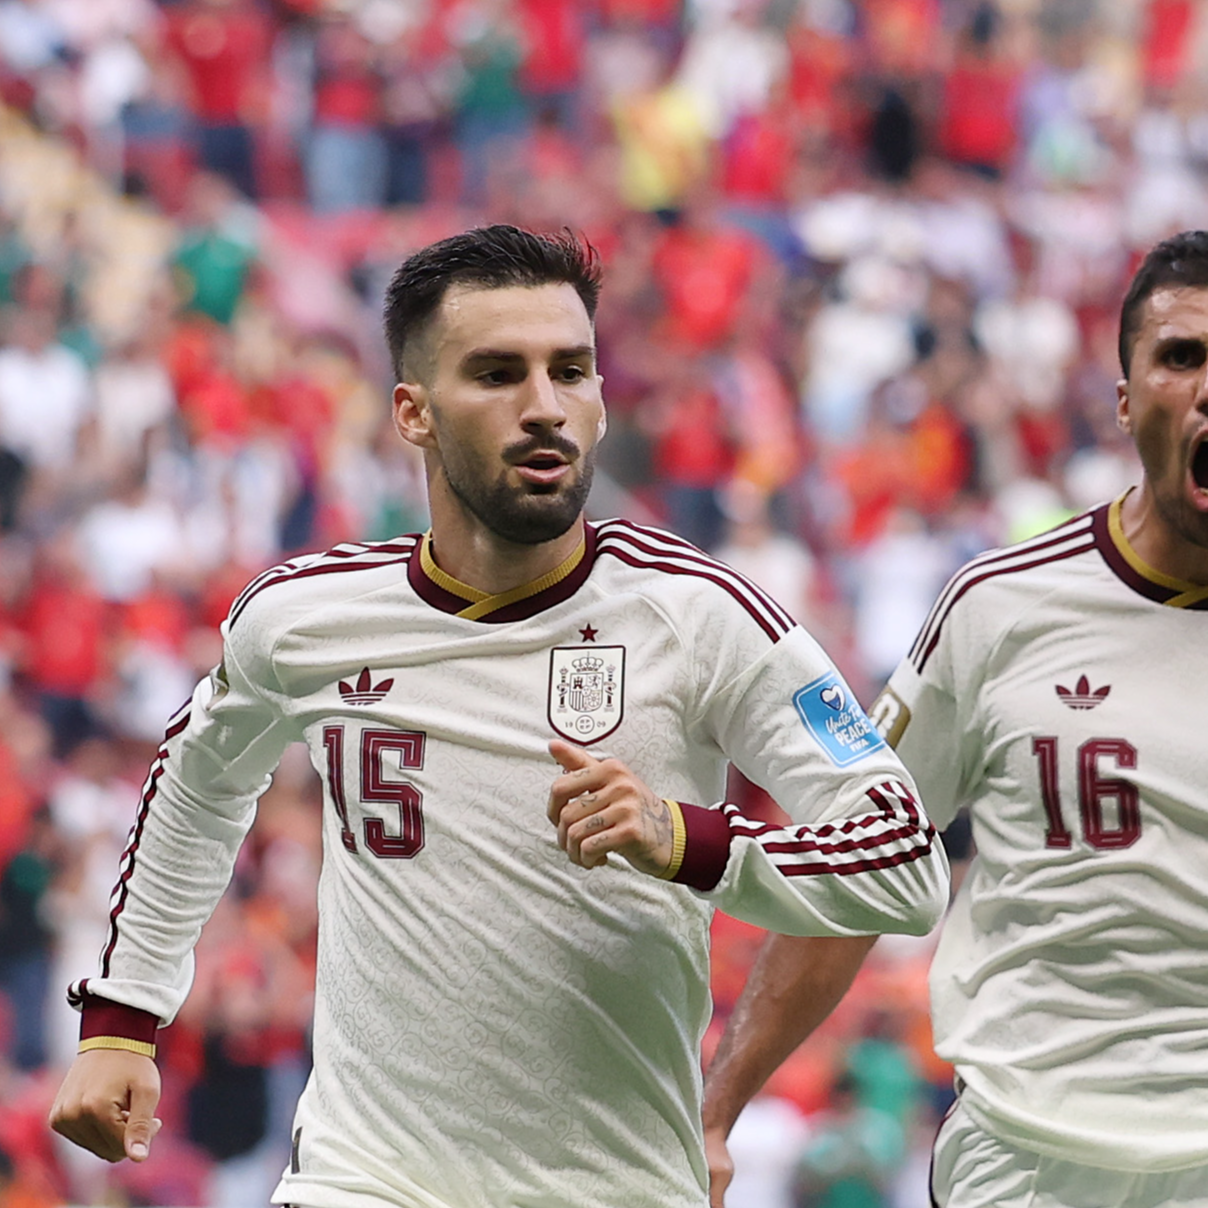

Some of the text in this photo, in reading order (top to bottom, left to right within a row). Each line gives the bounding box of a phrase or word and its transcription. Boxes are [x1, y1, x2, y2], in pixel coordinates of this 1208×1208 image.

[834, 717, 872, 747] PEACE
[850, 738, 870, 753] FIFA
[323, 725, 427, 860] 15
[1031, 736, 1143, 852] 16
